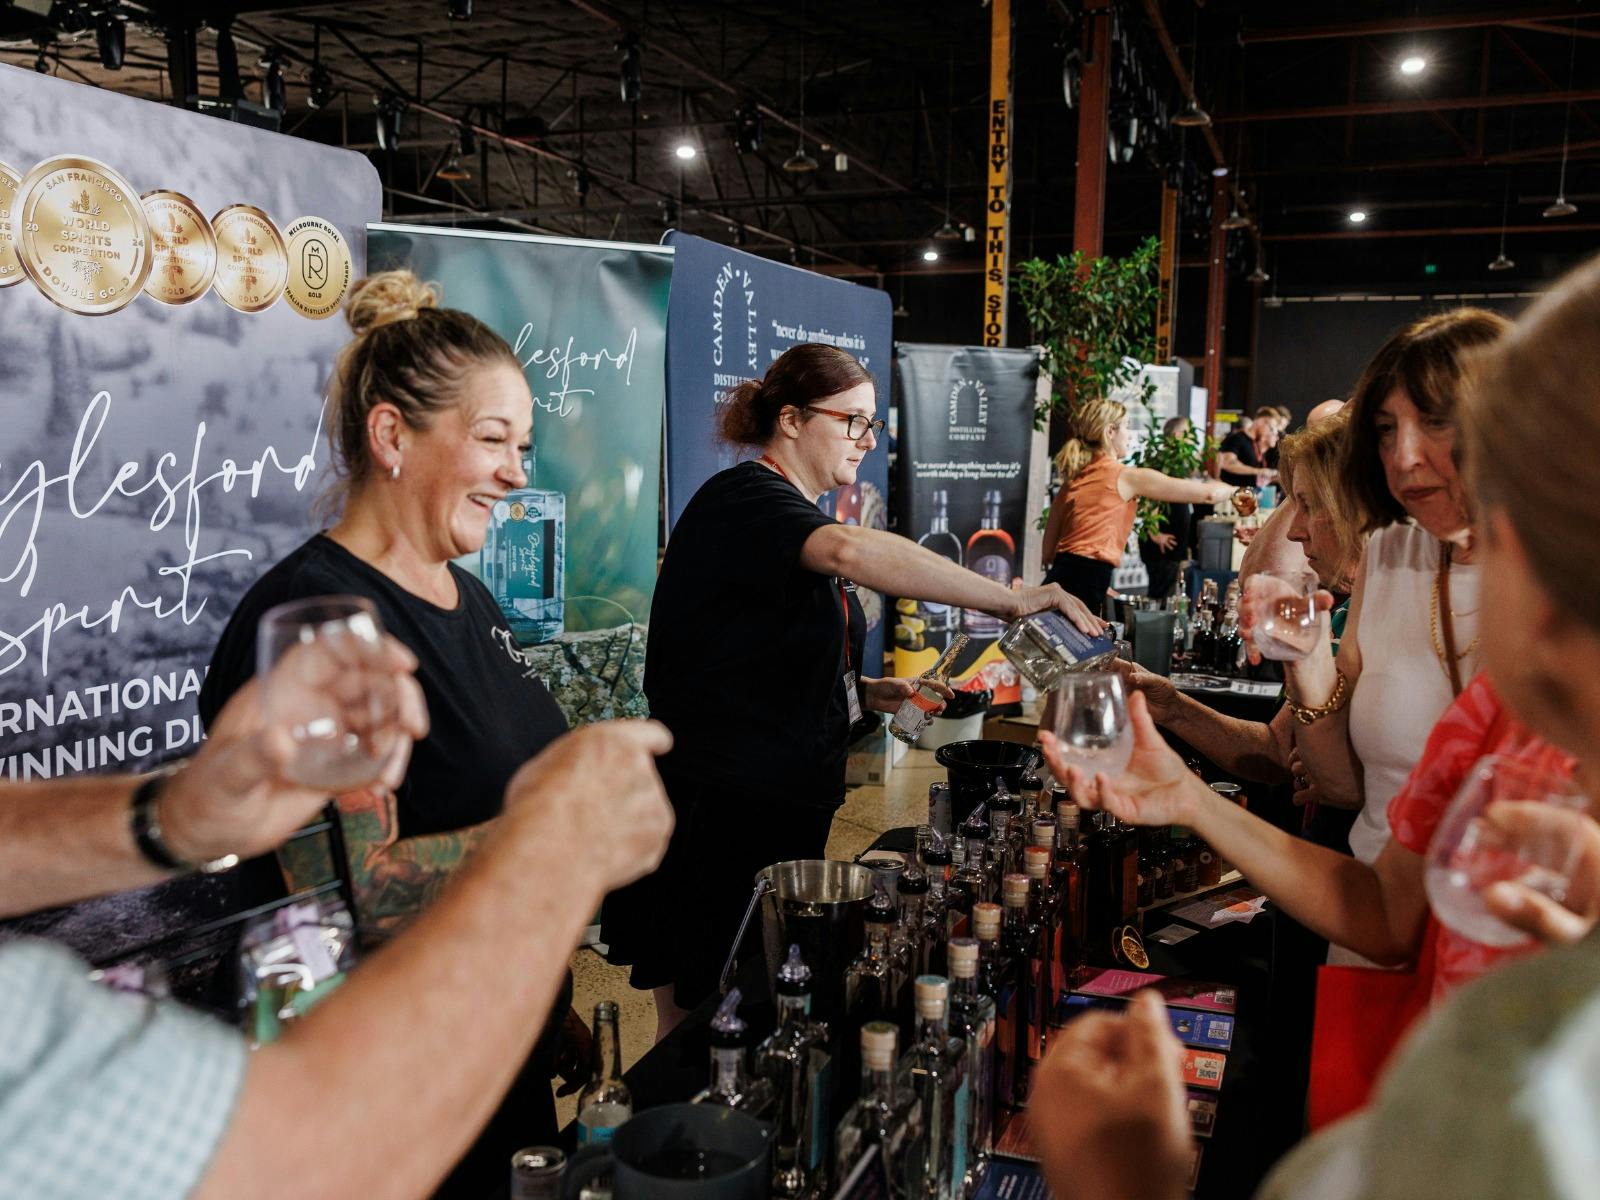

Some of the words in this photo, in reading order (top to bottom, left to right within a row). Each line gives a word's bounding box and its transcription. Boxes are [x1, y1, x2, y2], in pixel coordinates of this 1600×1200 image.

[991, 100, 1006, 173] ENTRY
[46, 176, 65, 189] SAN
[68, 172, 122, 201] FRANCISCO
[989, 185, 1004, 213] TO
[62, 231, 112, 247] SPIRITS
[64, 217, 111, 232] WORLD
[289, 221, 322, 237] MELBOURNE
[324, 225, 340, 243] ROYAL
[53, 244, 121, 260] COMPETITION
[988, 227, 1003, 282] THIS
[42, 266, 95, 300] DOUBLE
[162, 287, 184, 296] GOLD
[285, 286, 304, 310] TRALIAN
[304, 307, 330, 315] DISTILLED
[713, 262, 733, 366] CAMDEN
[742, 270, 757, 370] VALLEY
[513, 322, 637, 386] lesford
[950, 378, 966, 424] CAMDEN
[975, 380, 987, 425] VALLEY
[0, 665, 210, 737] RNATIONA
